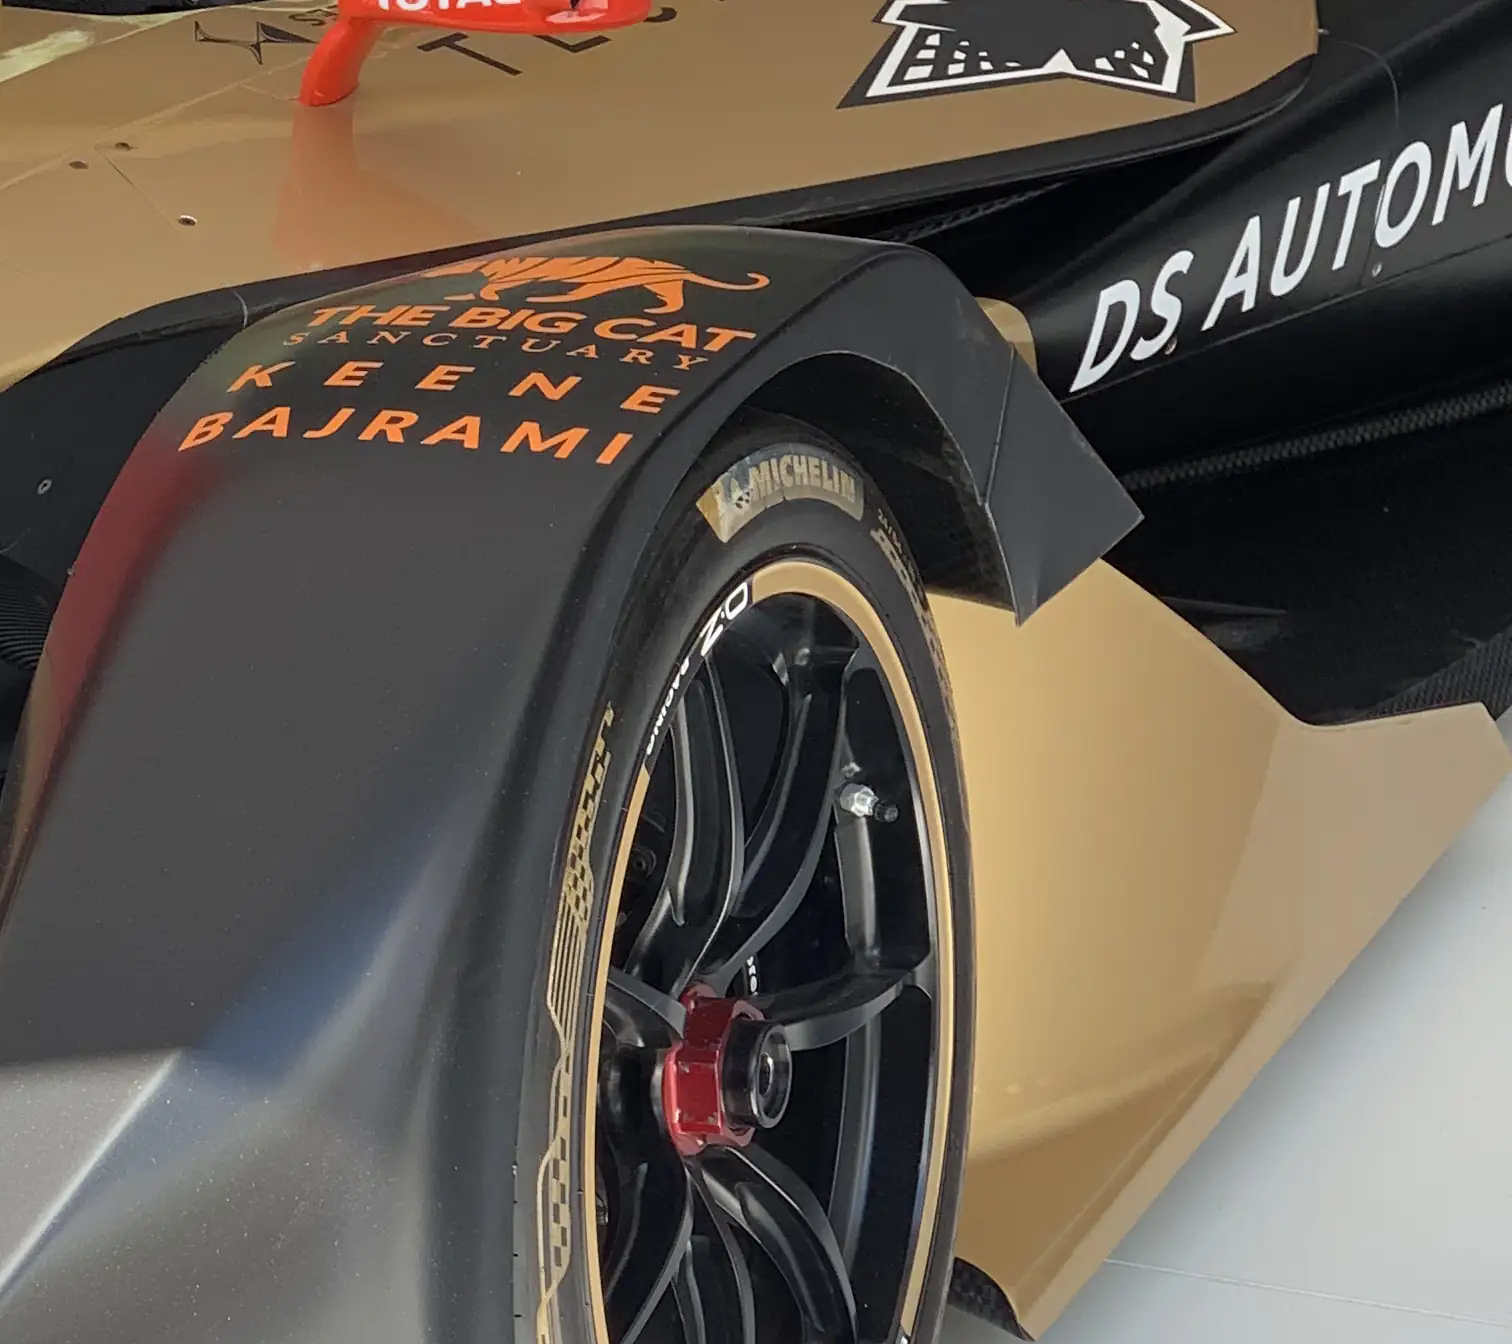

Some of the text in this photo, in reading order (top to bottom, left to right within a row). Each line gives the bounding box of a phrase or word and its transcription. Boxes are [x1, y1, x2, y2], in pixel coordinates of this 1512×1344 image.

[1069, 103, 1512, 393] DS AUTOM
[282, 331, 709, 372] SANCTUARY
[307, 303, 758, 353] THE BIG CAT
[226, 360, 681, 415] KEENE
[178, 406, 635, 466] BAJRAMI
[748, 454, 857, 503] MICHELIN
